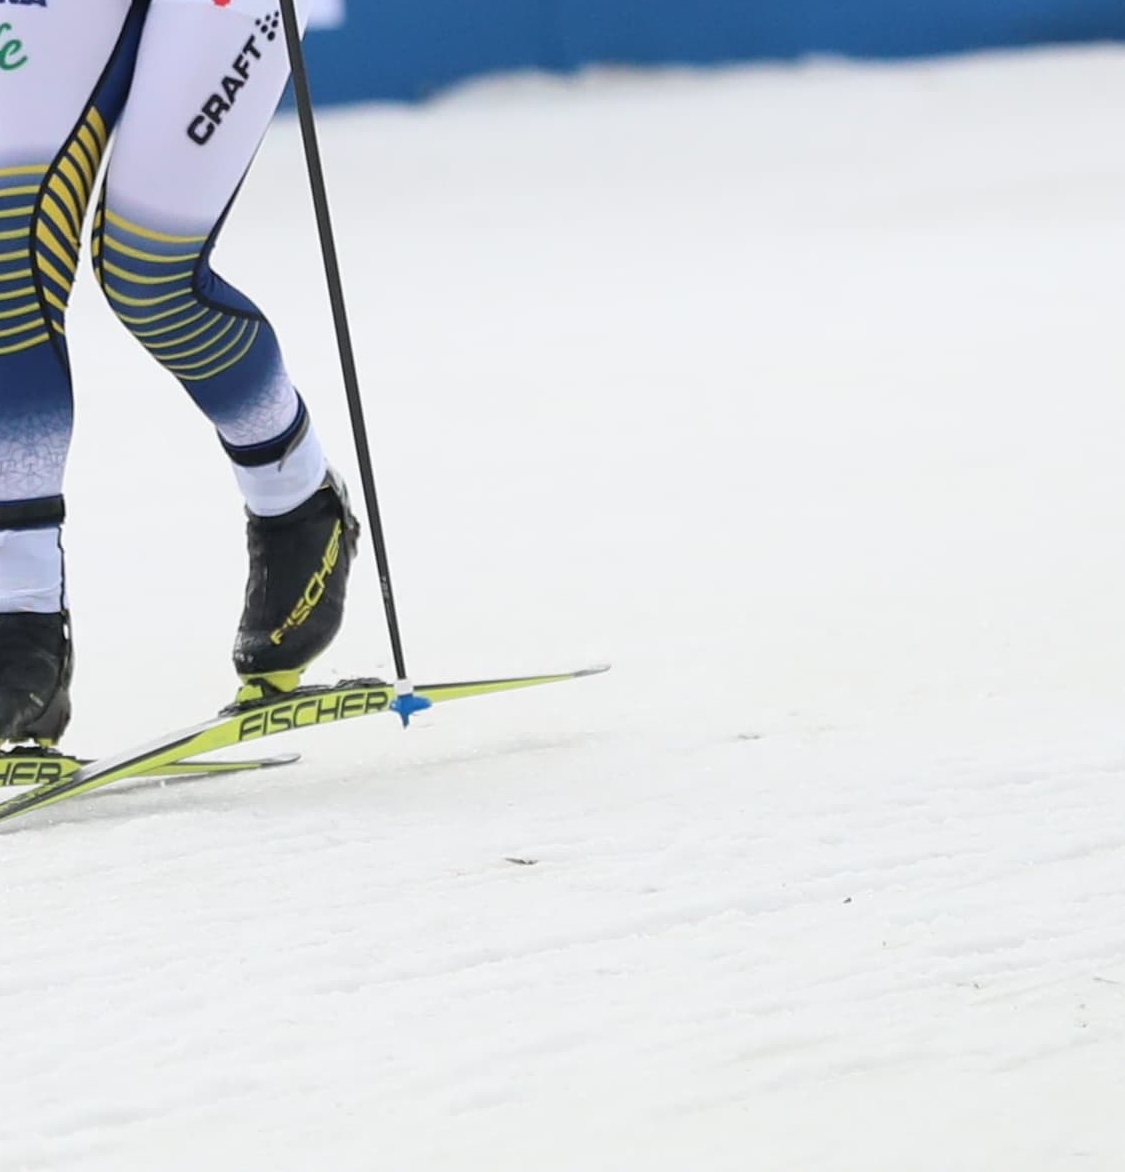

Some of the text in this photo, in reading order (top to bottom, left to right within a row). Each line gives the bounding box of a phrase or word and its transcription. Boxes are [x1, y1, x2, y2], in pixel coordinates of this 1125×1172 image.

[186, 35, 262, 146] CRAFT
[270, 519, 342, 644] FISCHER
[238, 691, 389, 740] FISCHER
